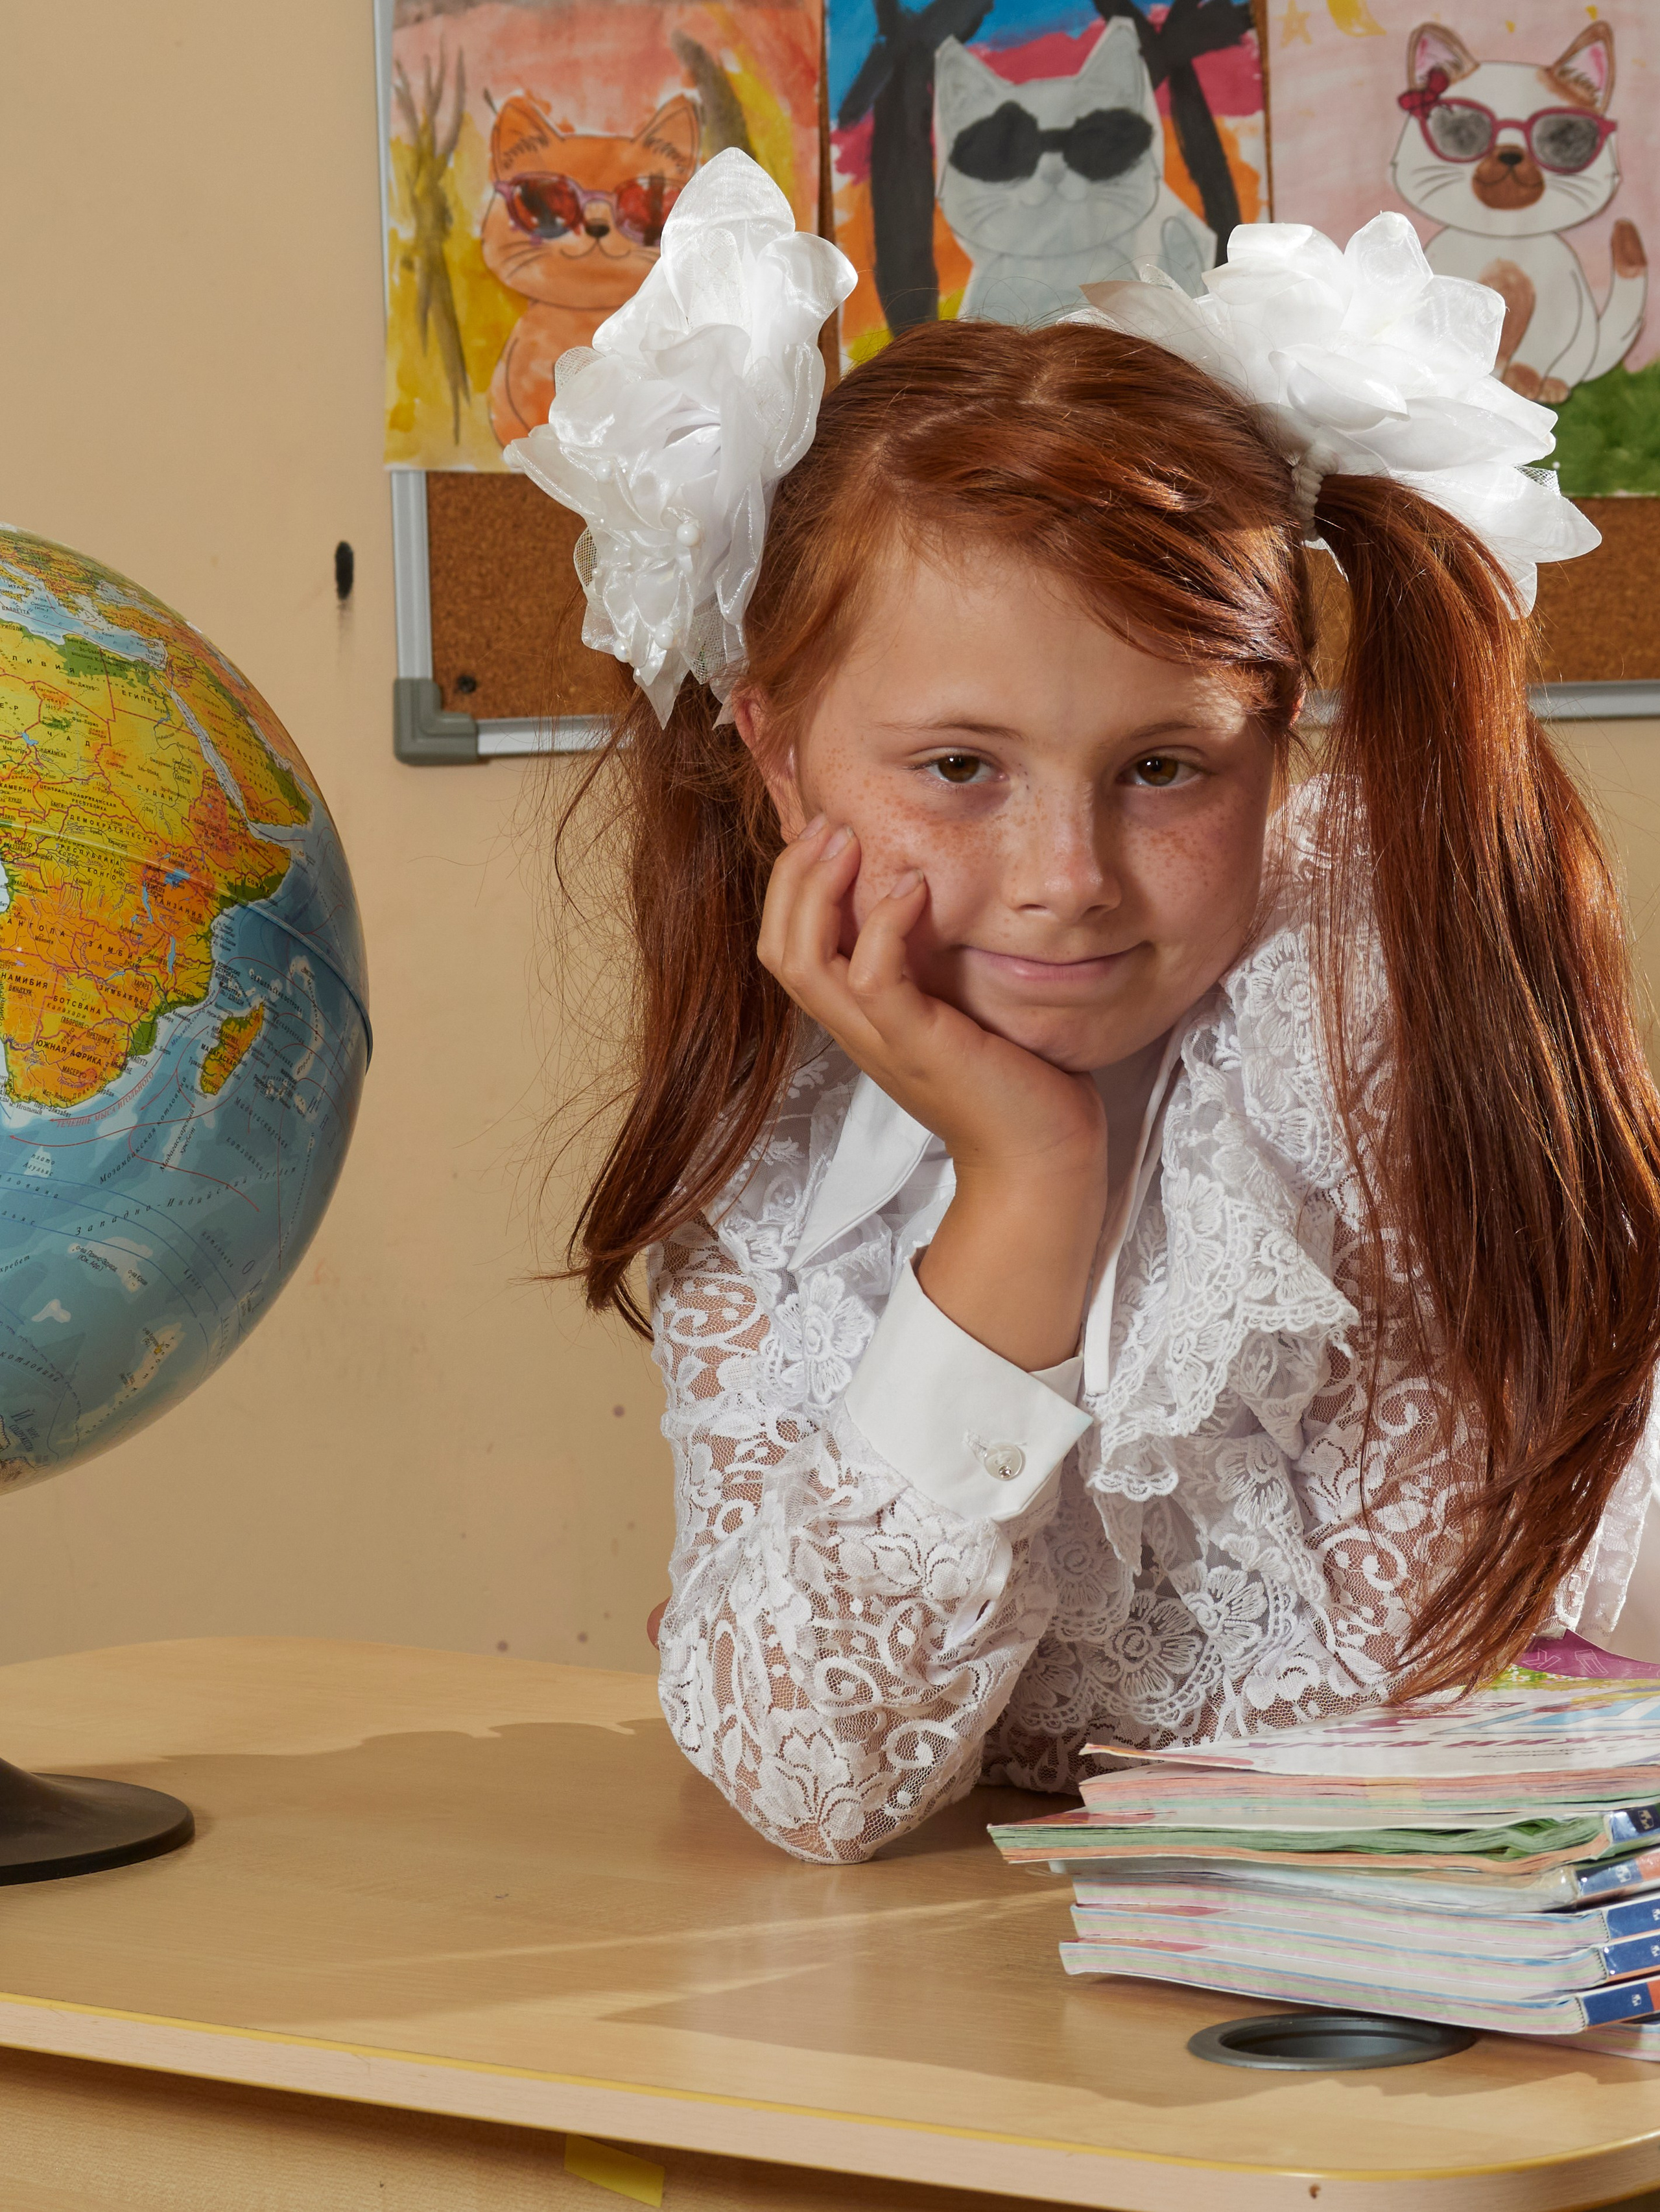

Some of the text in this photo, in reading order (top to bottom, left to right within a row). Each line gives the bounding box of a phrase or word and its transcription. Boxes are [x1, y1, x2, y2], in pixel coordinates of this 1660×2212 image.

[12, 655, 75, 674] ЛИВИЯ
[122, 690, 158, 705] ЕГИПЕТ
[47, 731, 91, 747] ЧАД
[40, 784, 117, 808] ЦЕНТРАЛЬНОАФРИКАНСКАЯ
[137, 784, 173, 802] СУДАН
[71, 798, 107, 811] РЕСПУБЛИКА
[70, 814, 158, 845] ДЕМОКРАТИЧЕСКАЯ
[60, 844, 120, 866] РЕСПУБЛИКА
[87, 867, 116, 881] КОНГО
[155, 895, 202, 920] ТАНЗАНИЯ
[7, 918, 65, 937] АНГОЛА
[88, 940, 142, 963] ЗАМБИЯ
[1, 972, 48, 989] НАМИБИЯ
[99, 984, 144, 1004] ЗИМБАБВЕ
[47, 1003, 86, 1019] Калахари
[53, 995, 101, 1015] БОТСВАНА
[36, 1039, 67, 1054] ЮЖНАЯ
[69, 1050, 101, 1066] АФРИКА
[201, 1043, 237, 1066] МАДАГАСКАР
[56, 1071, 154, 1128] ТЕЧЕНИЕ МЫСА ИГОЛЬНОГО
[97, 1086, 115, 1098] Дурбан
[16, 1103, 43, 1115] Игольный
[34, 1101, 72, 1118] Порт-Элизабет
[30, 1153, 56, 1165] плато
[22, 1161, 54, 1177] Агульяс
